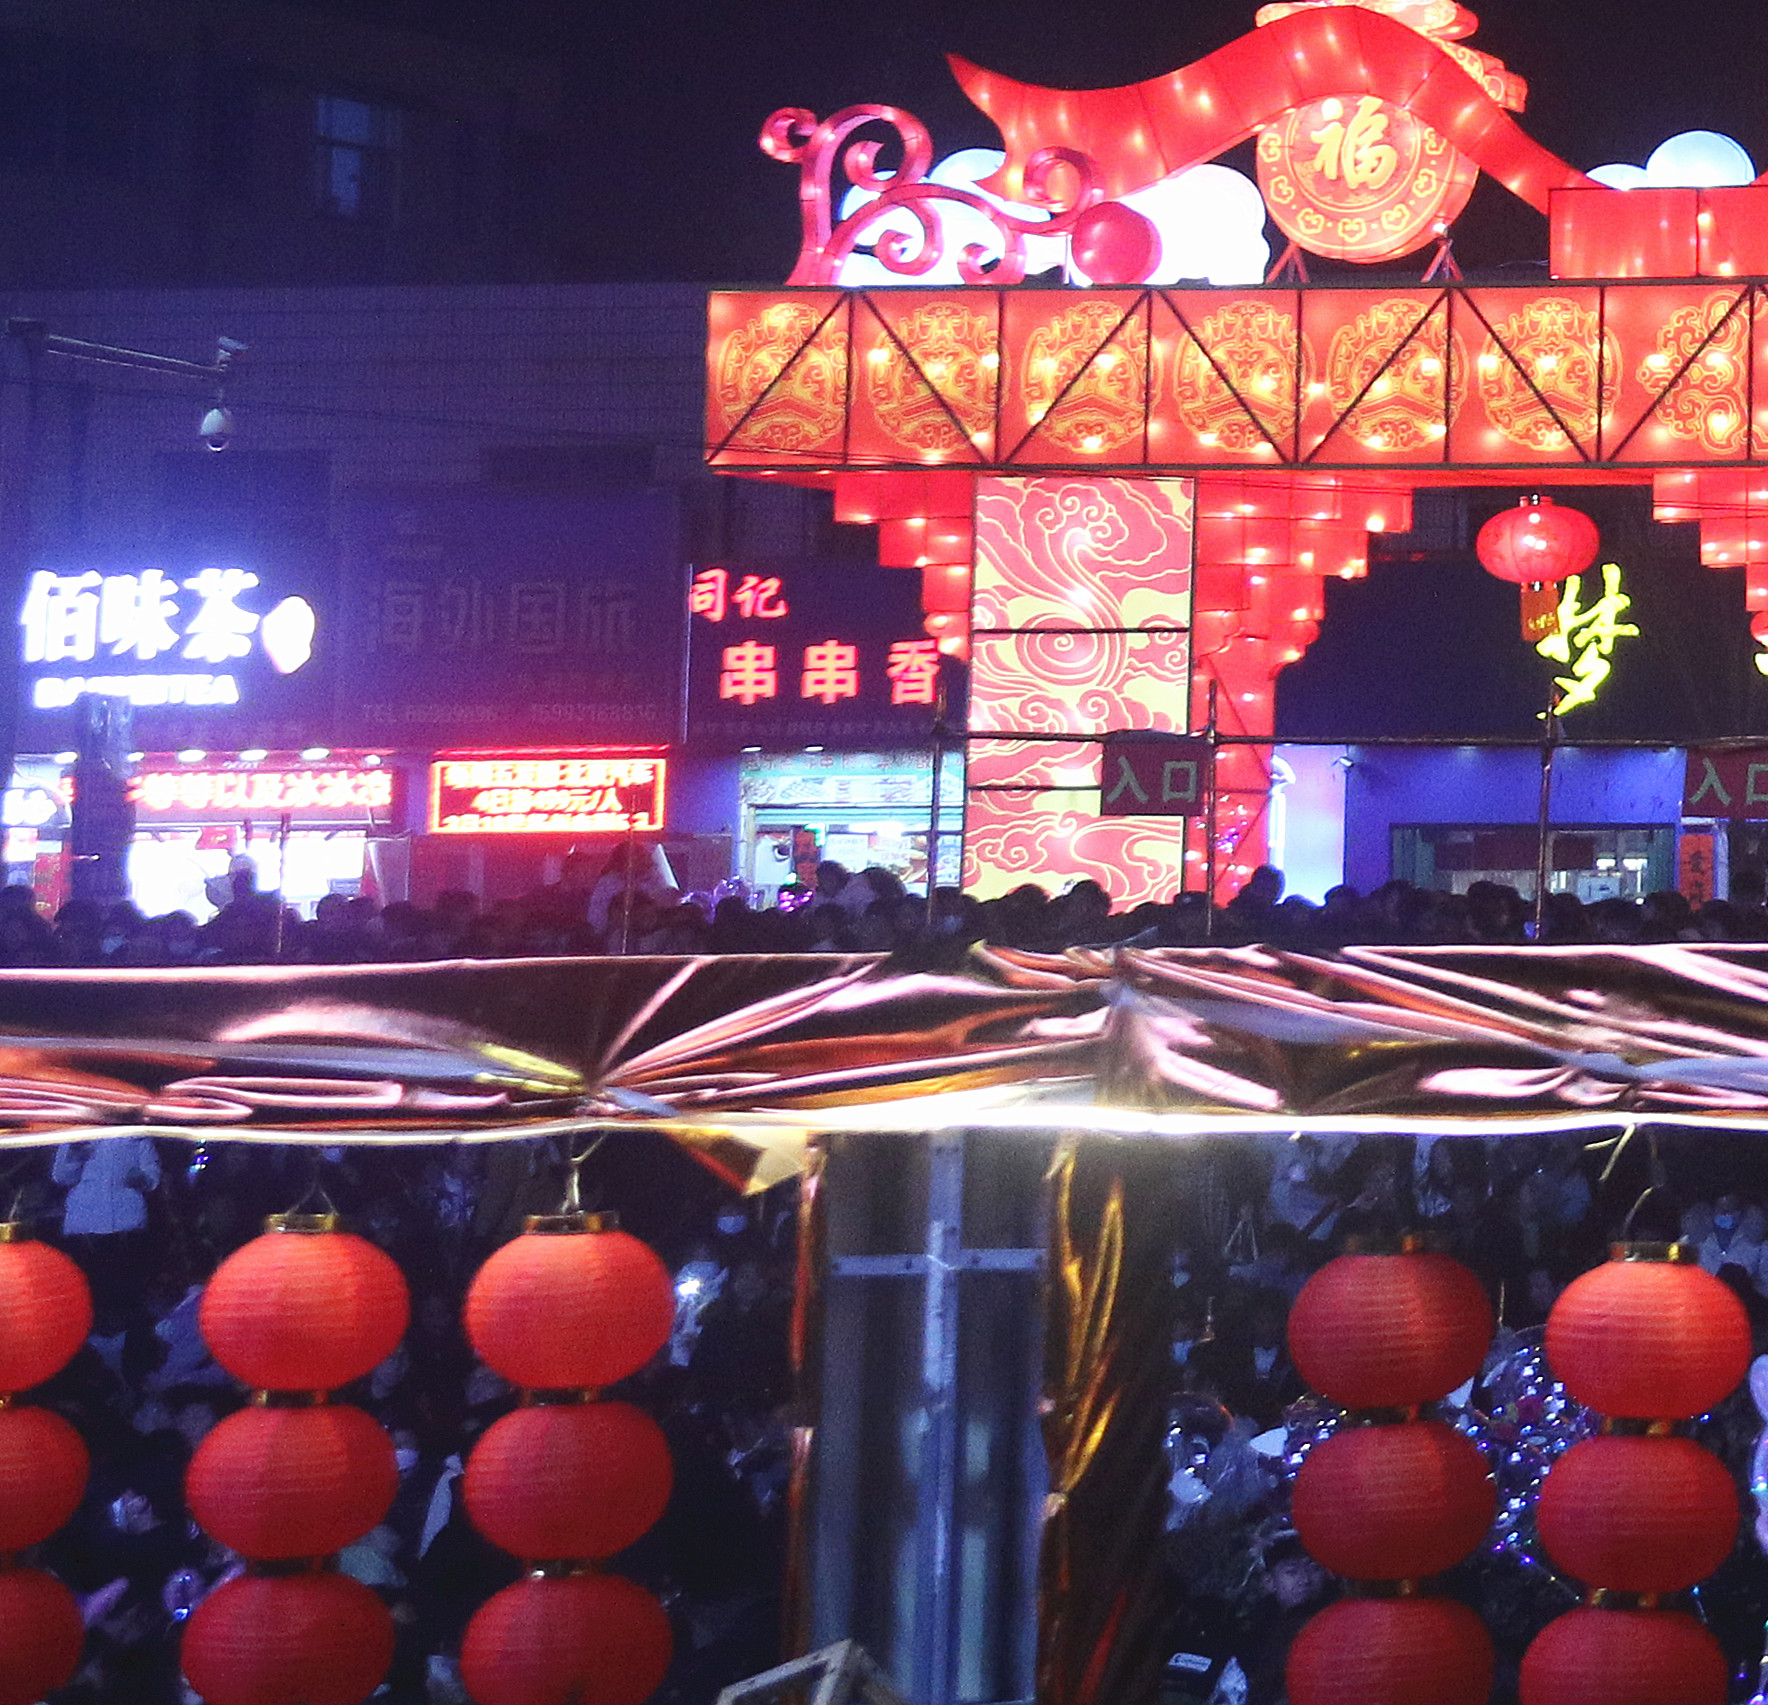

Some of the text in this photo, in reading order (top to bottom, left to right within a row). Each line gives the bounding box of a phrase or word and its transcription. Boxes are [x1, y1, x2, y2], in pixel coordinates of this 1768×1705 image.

[1311, 96, 1400, 191] 福
[720, 639, 941, 706] 串串香
[1106, 756, 1198, 804] 入口
